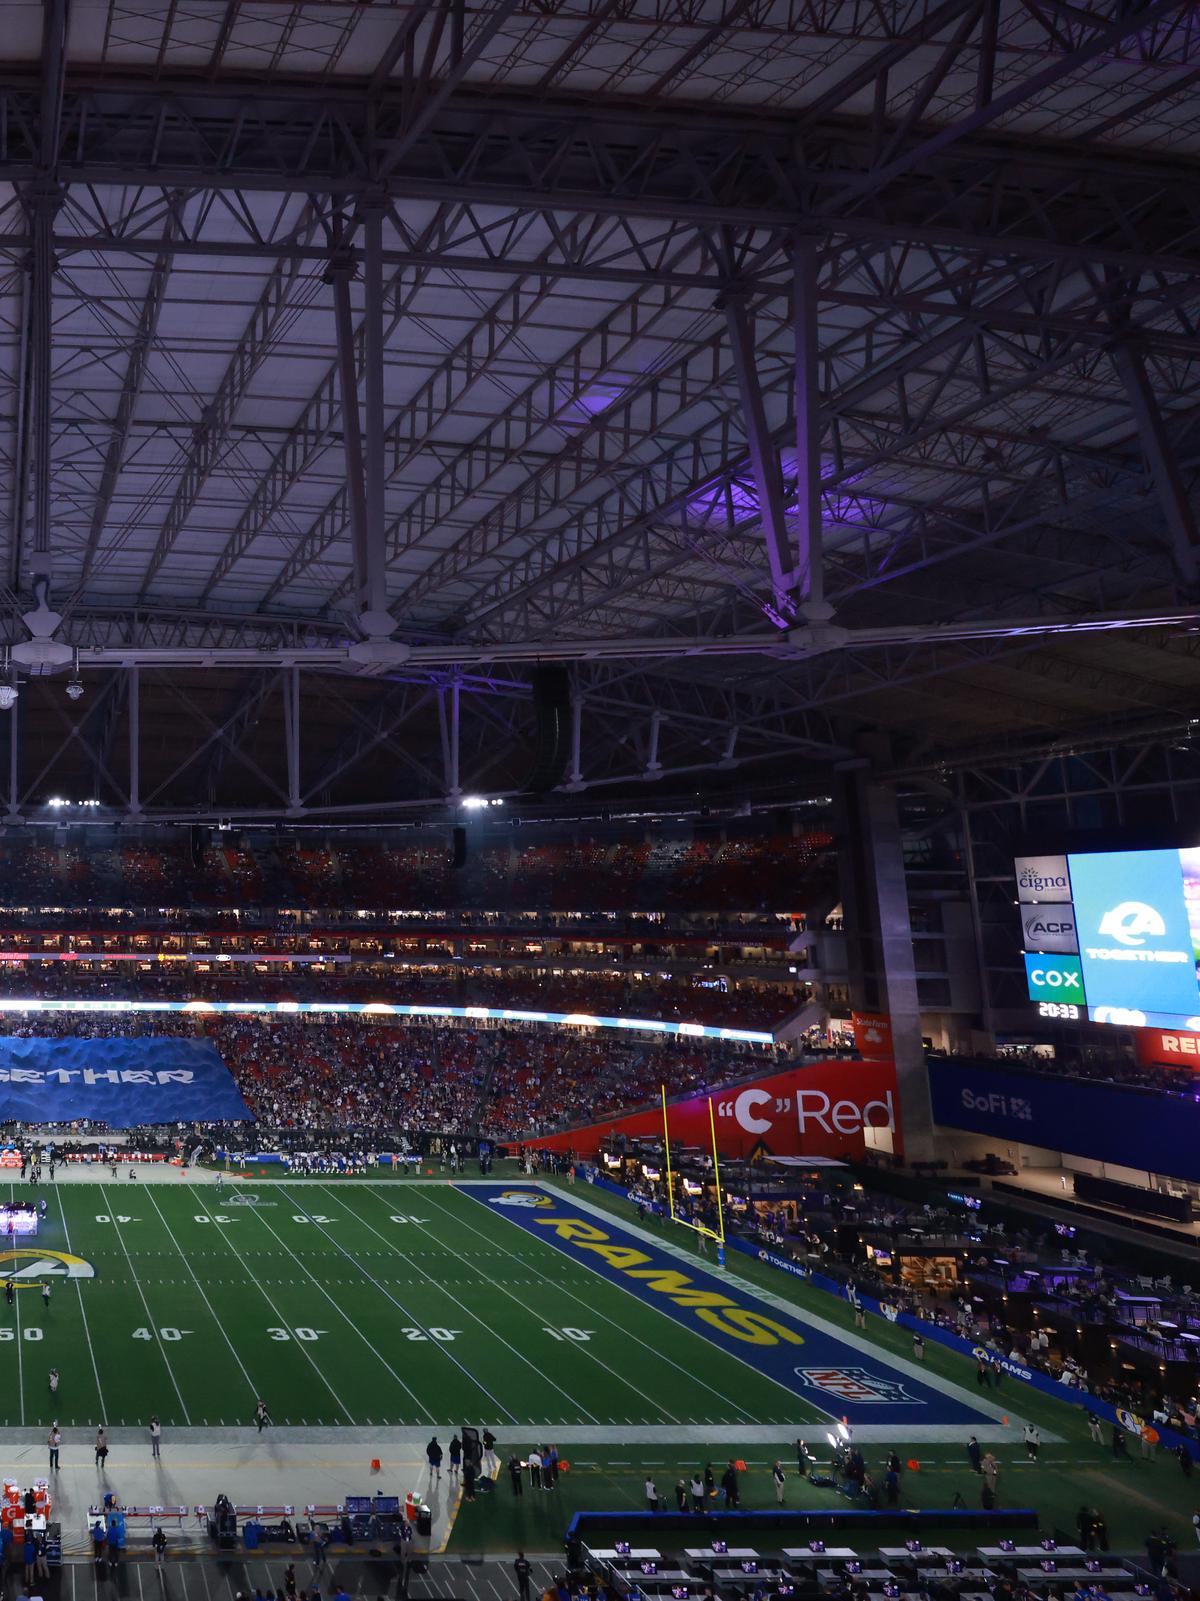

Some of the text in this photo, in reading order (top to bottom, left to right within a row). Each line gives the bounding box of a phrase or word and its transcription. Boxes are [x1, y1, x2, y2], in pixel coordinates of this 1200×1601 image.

[1019, 875, 1066, 891] cigna
[1033, 922, 1073, 934] ACP
[1087, 948, 1189, 963] TOGETHER
[1030, 969, 1080, 988] COX
[961, 1088, 1007, 1115] SoFi
[796, 1090, 895, 1134] Red
[534, 1218, 804, 1345] RAMS
[132, 1328, 182, 1341] 40
[266, 1328, 319, 1341] 30
[400, 1328, 456, 1341] 20
[542, 1328, 591, 1341] 10
[806, 1370, 877, 1399] NFL
